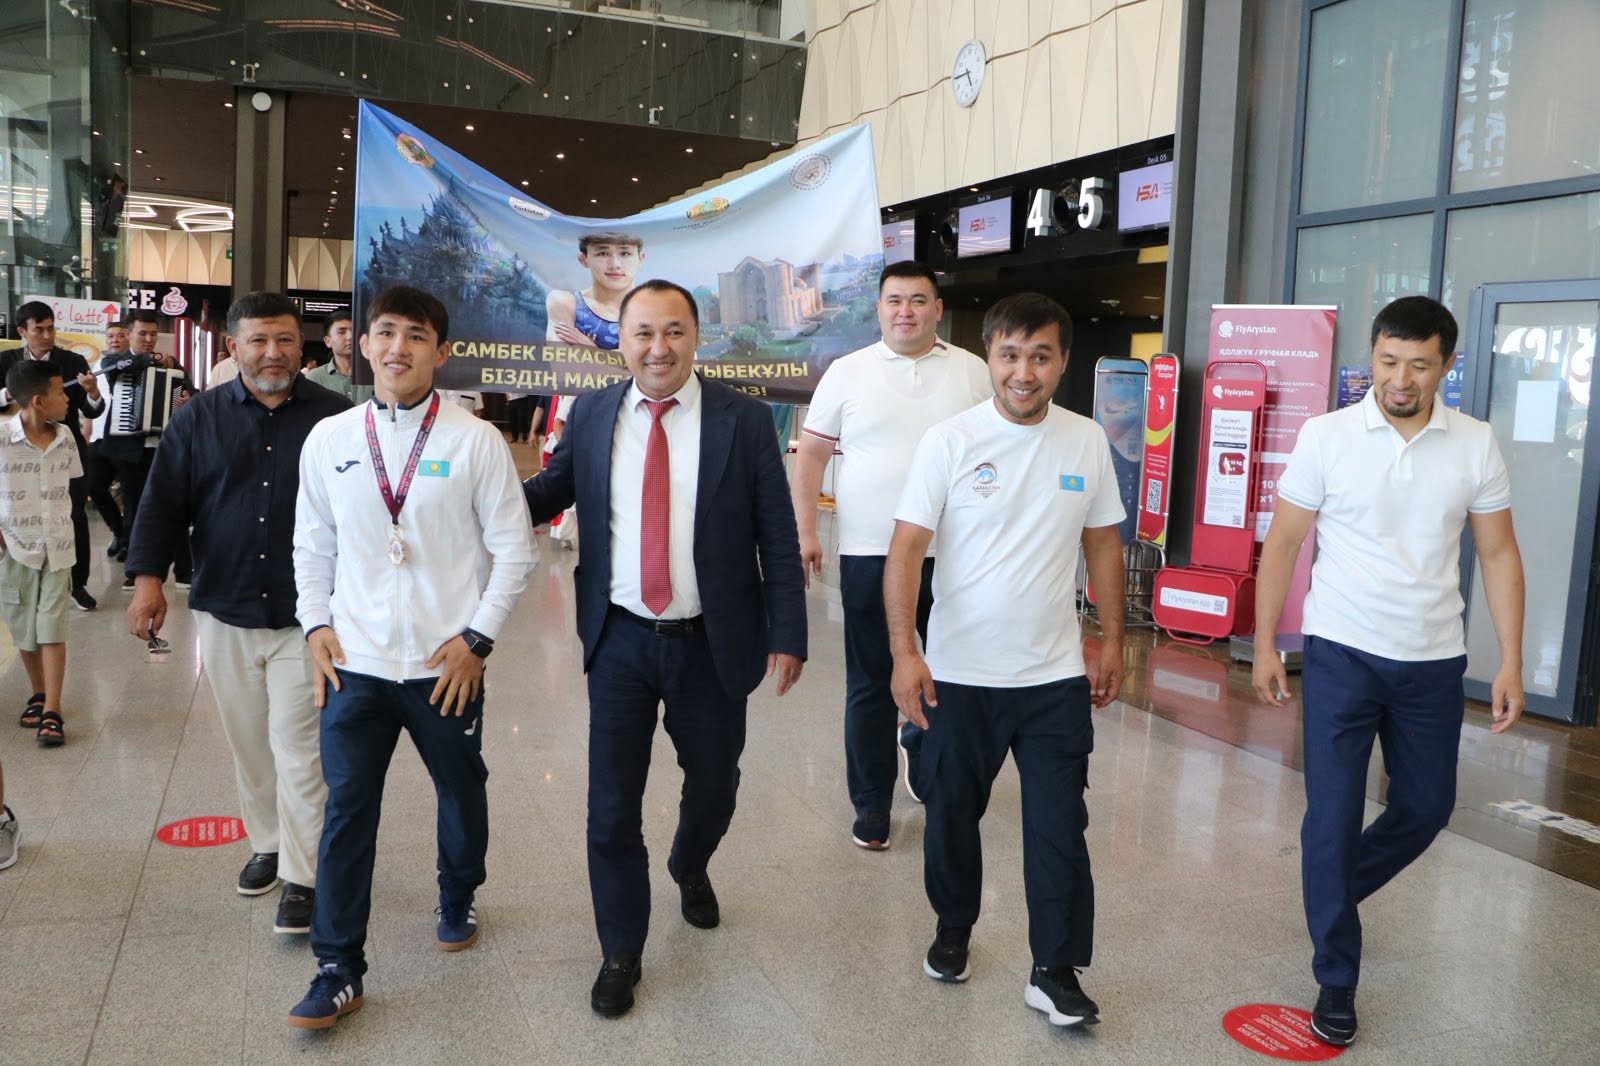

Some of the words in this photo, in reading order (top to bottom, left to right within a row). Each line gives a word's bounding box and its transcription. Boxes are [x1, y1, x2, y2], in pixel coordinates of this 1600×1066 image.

[1027, 188, 1049, 237] 4
[1077, 176, 1102, 229] 5
[1235, 325, 1277, 335] FlyArystan
[448, 341, 537, 361] САМБЕК
[542, 346, 628, 367] БЕКАСЫ
[1259, 348, 1290, 358] РУЧНАЯ
[1291, 349, 1319, 359] КЛАДЬ
[481, 367, 558, 390] БІЗДІҢ
[1224, 388, 1255, 397] FlyArystan
[1262, 480, 1274, 489] 10
[1260, 495, 1273, 503] x1
[1236, 1027, 1278, 1052] DISTANCE
[1242, 1023, 1266, 1037] KEEP
[1265, 1035, 1290, 1051] YOUR
